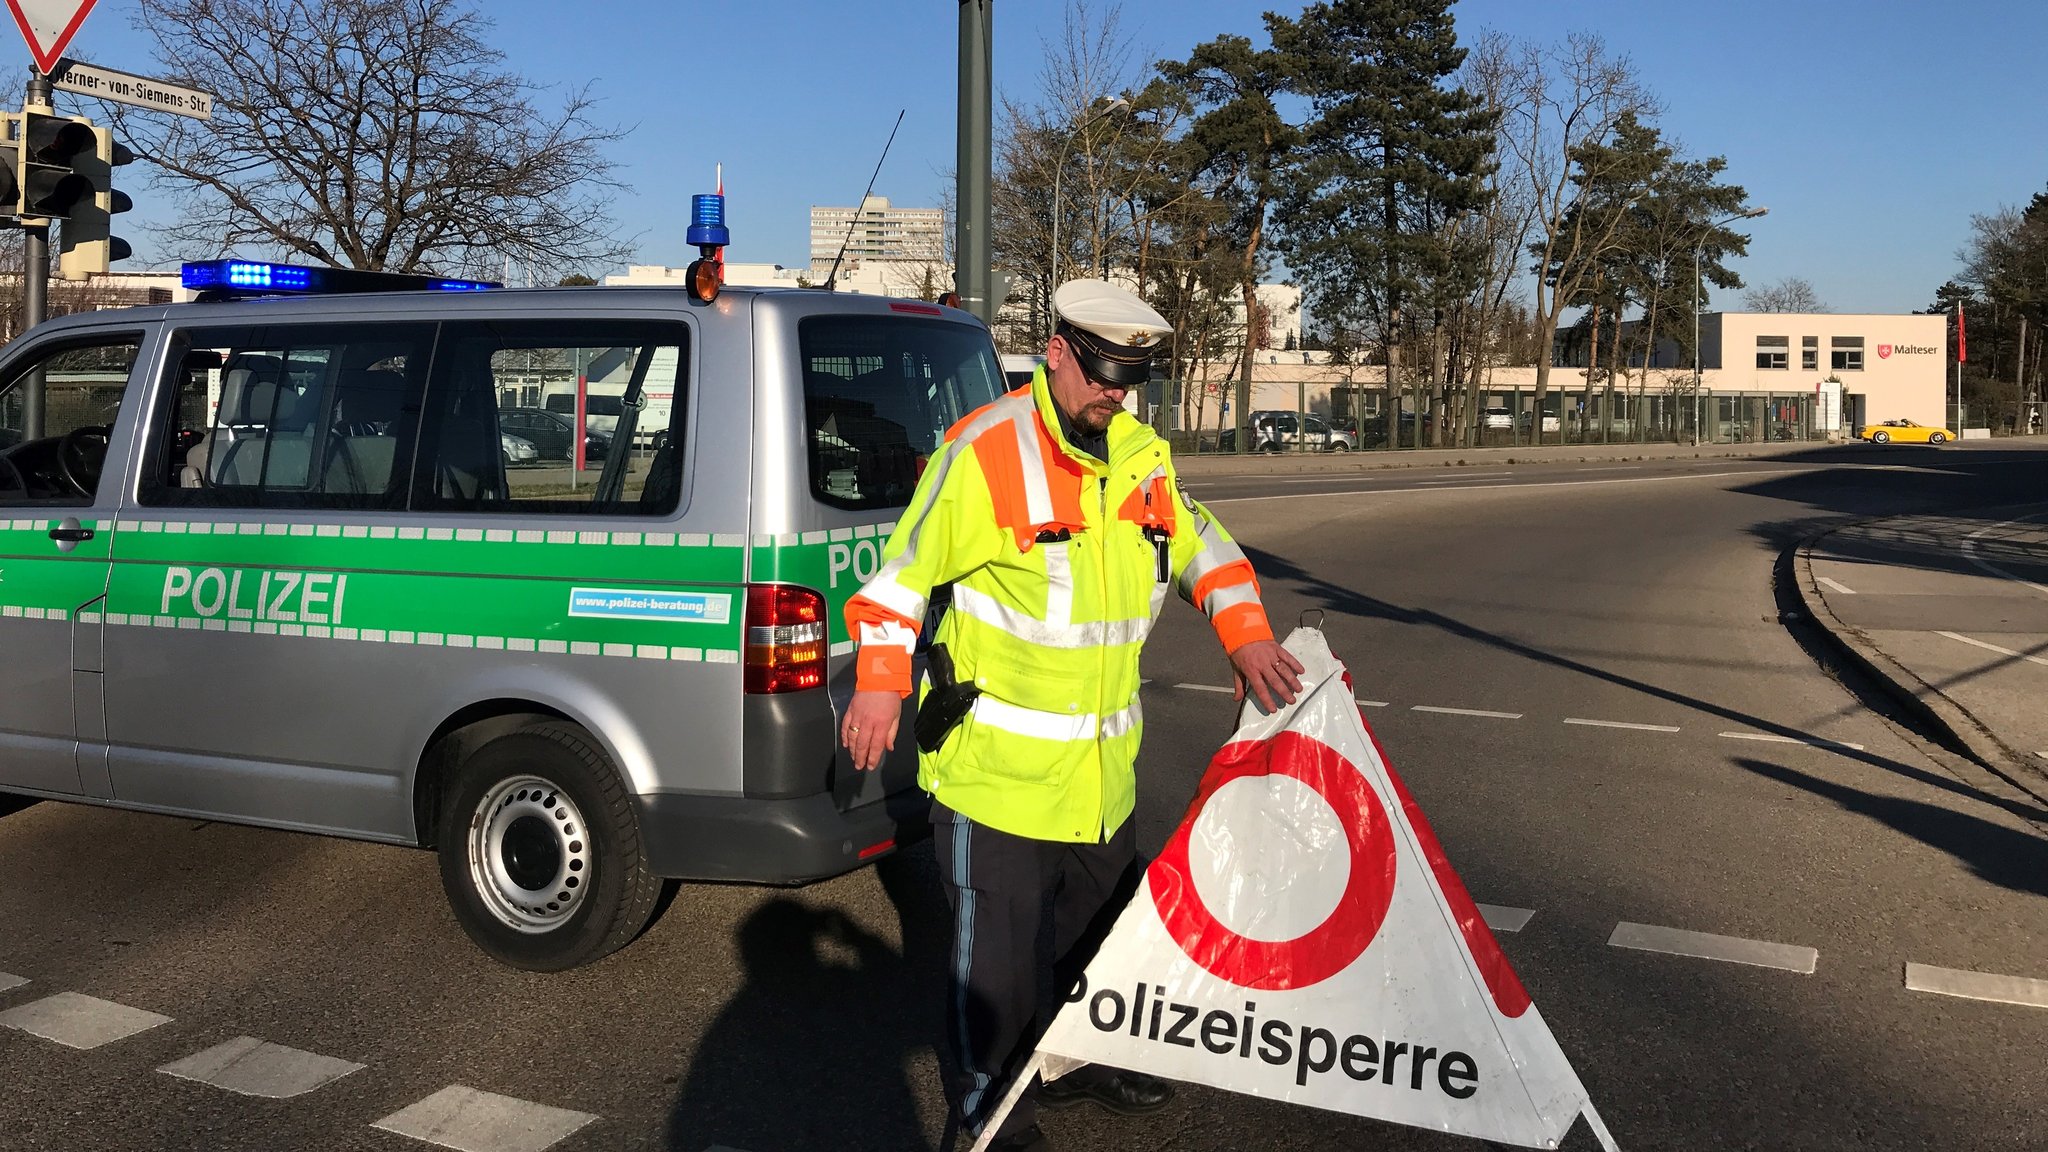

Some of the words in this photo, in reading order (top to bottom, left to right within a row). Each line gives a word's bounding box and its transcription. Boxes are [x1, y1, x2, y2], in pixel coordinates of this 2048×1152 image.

[1894, 344, 1938, 355] Malteser
[161, 566, 347, 625] POLIZEI
[575, 597, 722, 614] www.polizei-beratung.de
